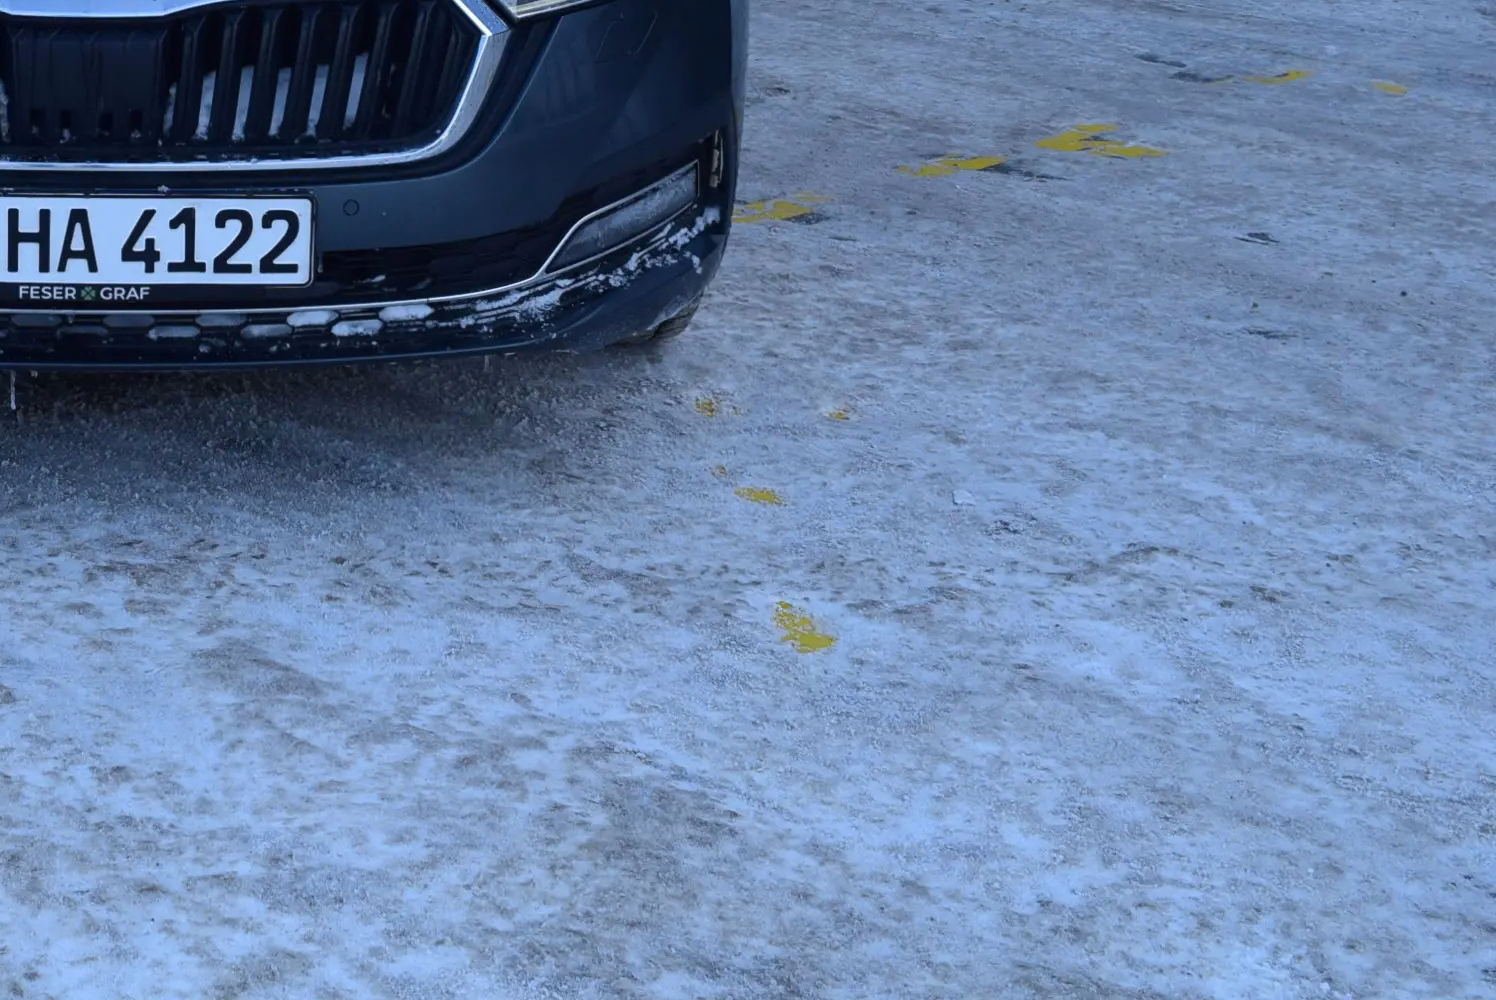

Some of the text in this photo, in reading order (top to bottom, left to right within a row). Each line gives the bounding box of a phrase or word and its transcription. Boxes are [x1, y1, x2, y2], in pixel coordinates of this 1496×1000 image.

[7, 208, 98, 273] HA
[121, 207, 300, 273] 4122
[19, 285, 150, 300] FESER GRAF
